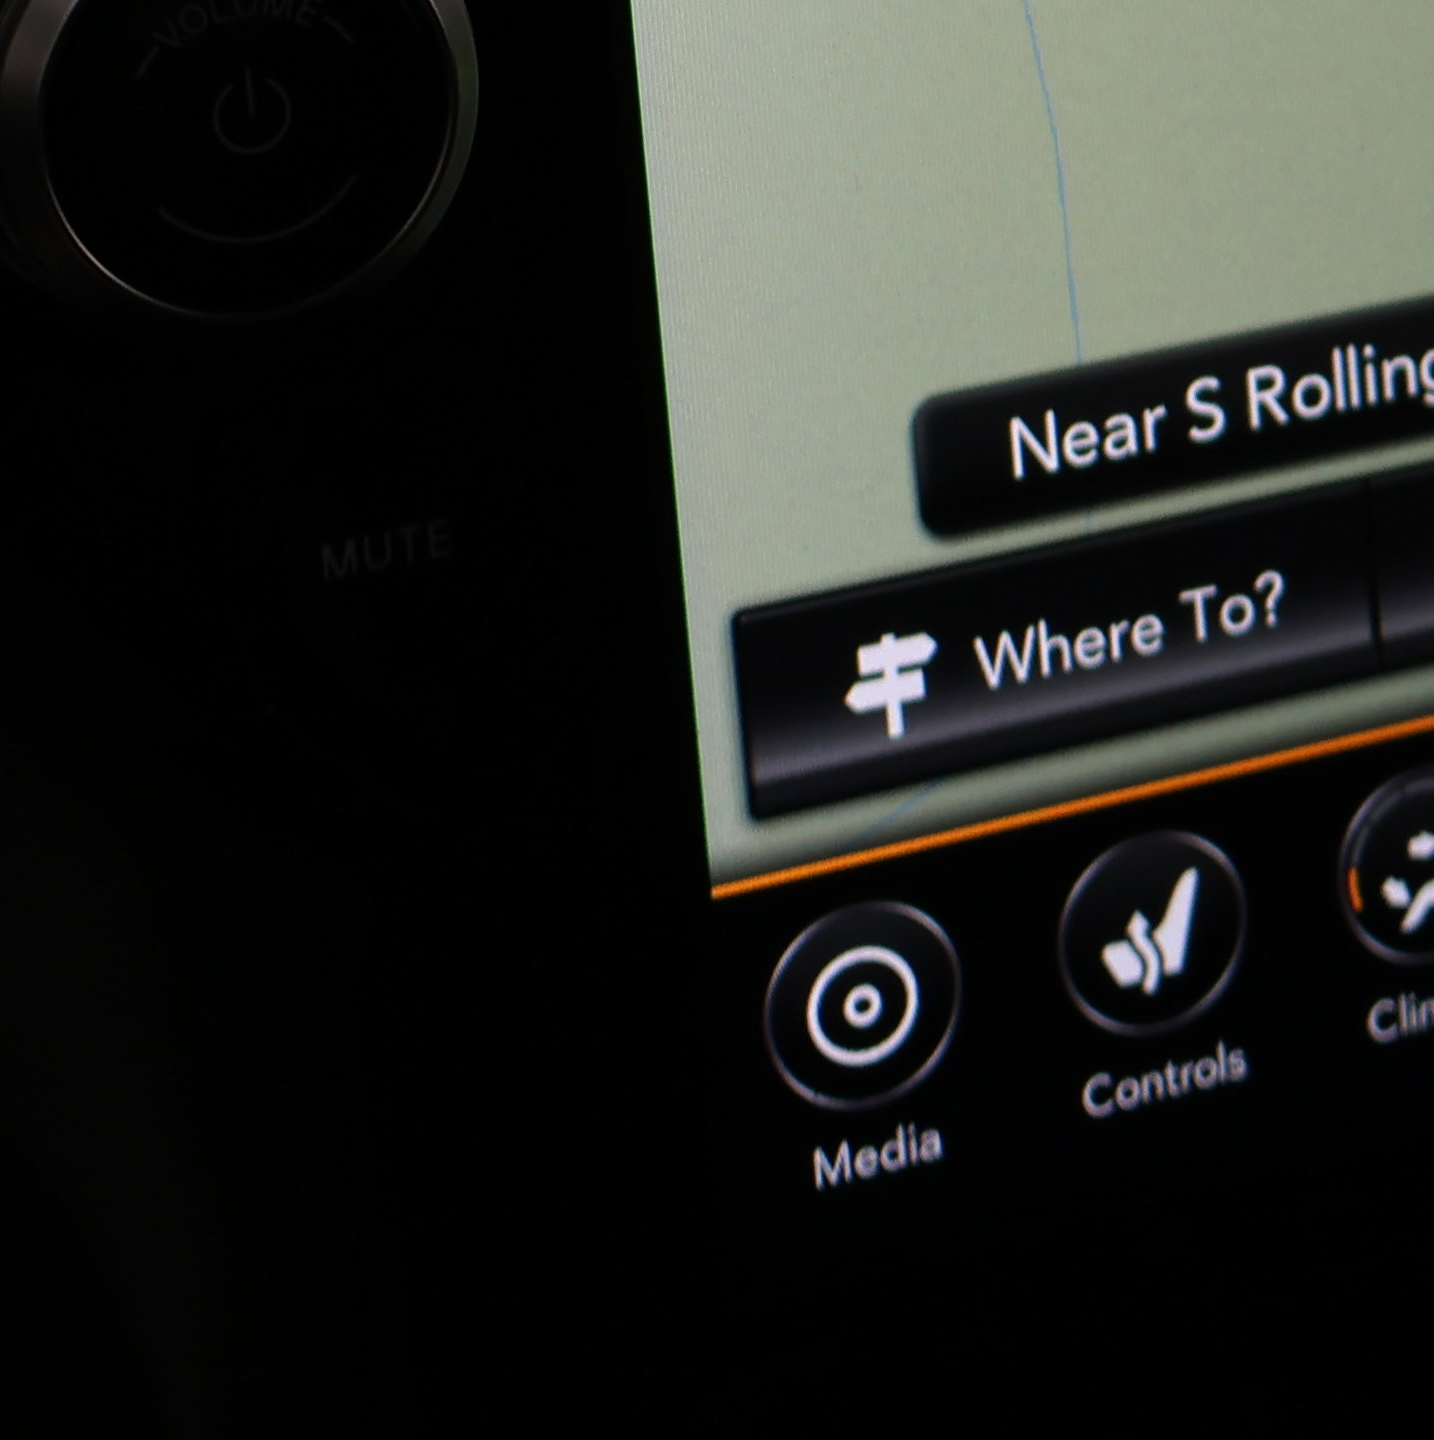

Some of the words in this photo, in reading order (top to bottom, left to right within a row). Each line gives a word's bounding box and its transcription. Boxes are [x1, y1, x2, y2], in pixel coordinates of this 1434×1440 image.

[1009, 405, 1167, 479] Near
[1185, 376, 1227, 442] S
[321, 519, 451, 581] MUTE
[973, 612, 1164, 691] Where
[1179, 570, 1285, 642] To?
[1082, 1042, 1249, 1117] Controls
[813, 1125, 943, 1188] Media
